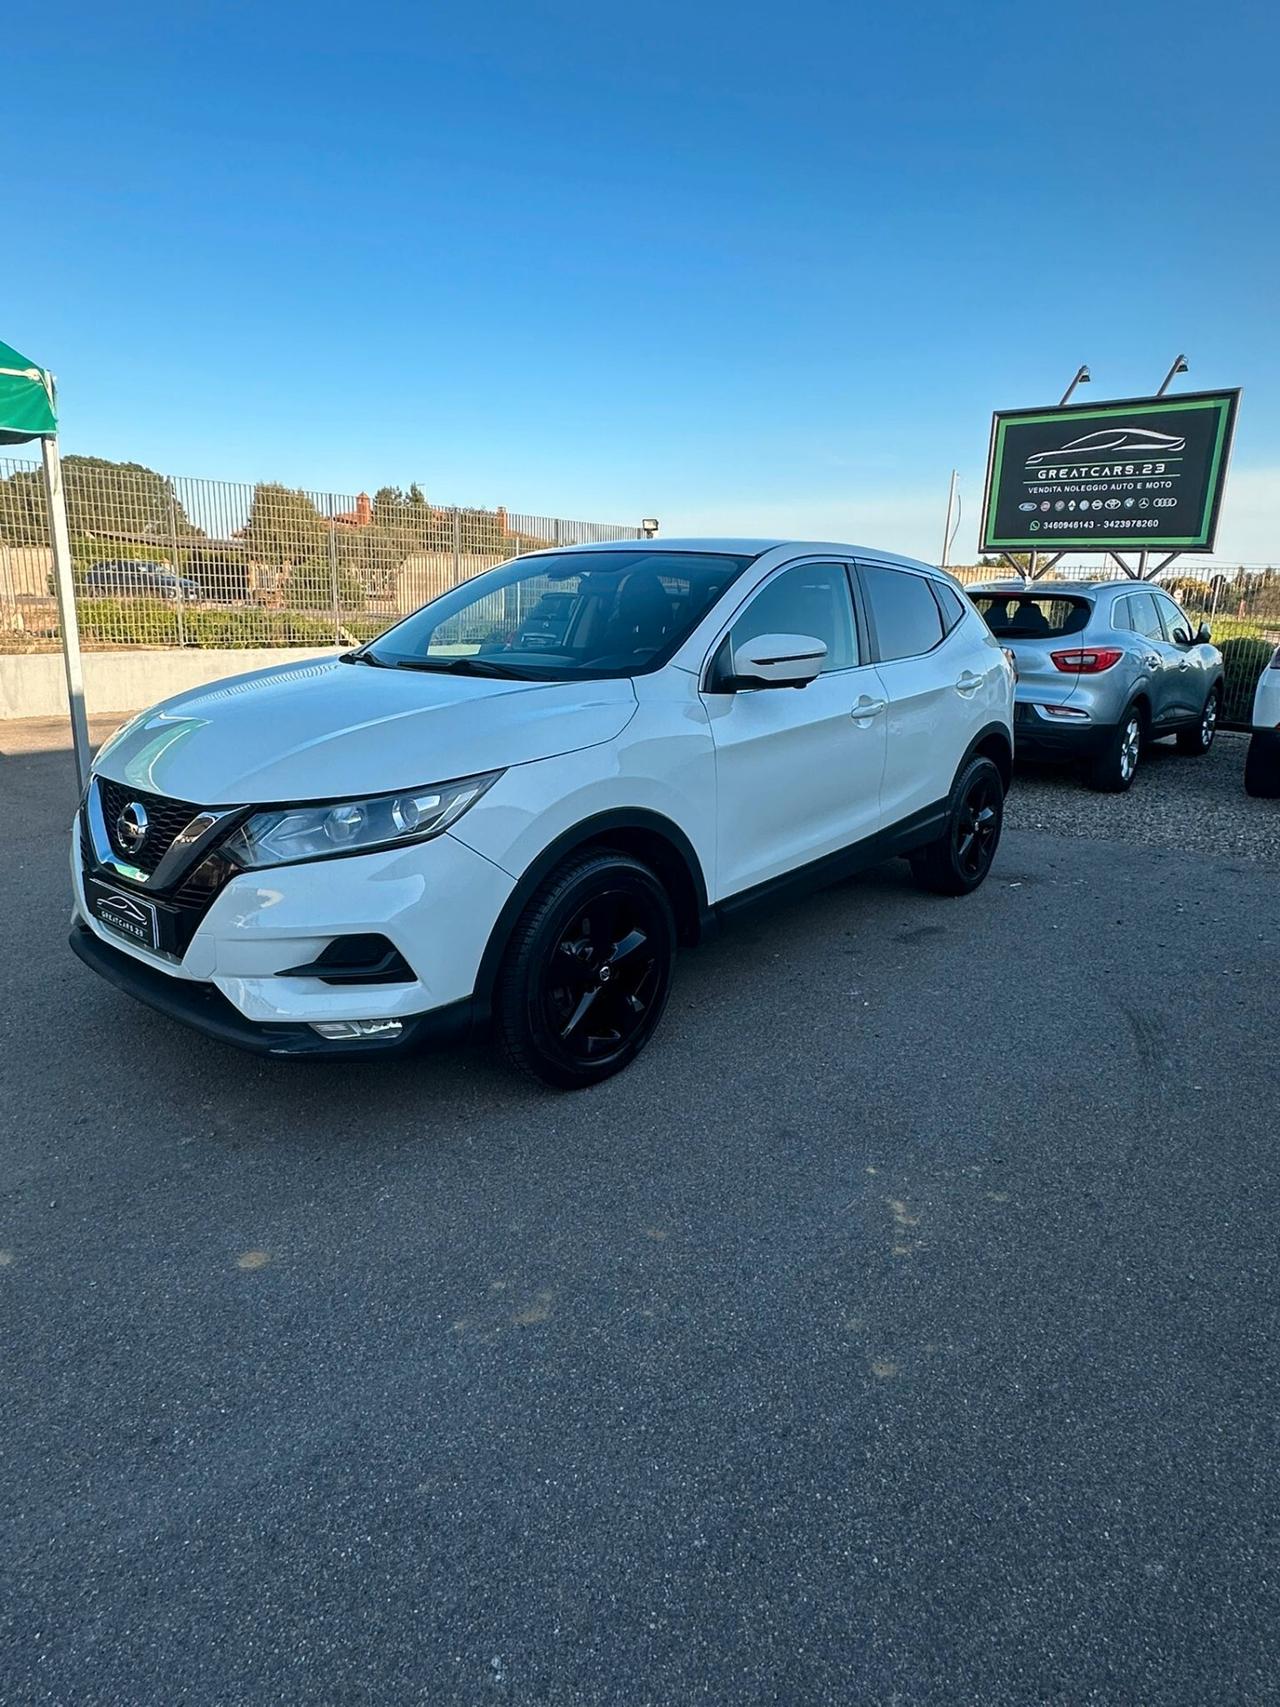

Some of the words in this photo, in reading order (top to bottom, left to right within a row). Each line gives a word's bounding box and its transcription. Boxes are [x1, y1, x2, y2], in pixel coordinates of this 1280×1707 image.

[1037, 463, 1166, 480] GREATCARS.23
[1028, 486, 1062, 494] VENDITA
[1064, 484, 1108, 493] NOLEGGIO
[1110, 482, 1134, 491] AUTO
[1145, 480, 1172, 489] MOTO
[1103, 519, 1159, 529] 3423978260
